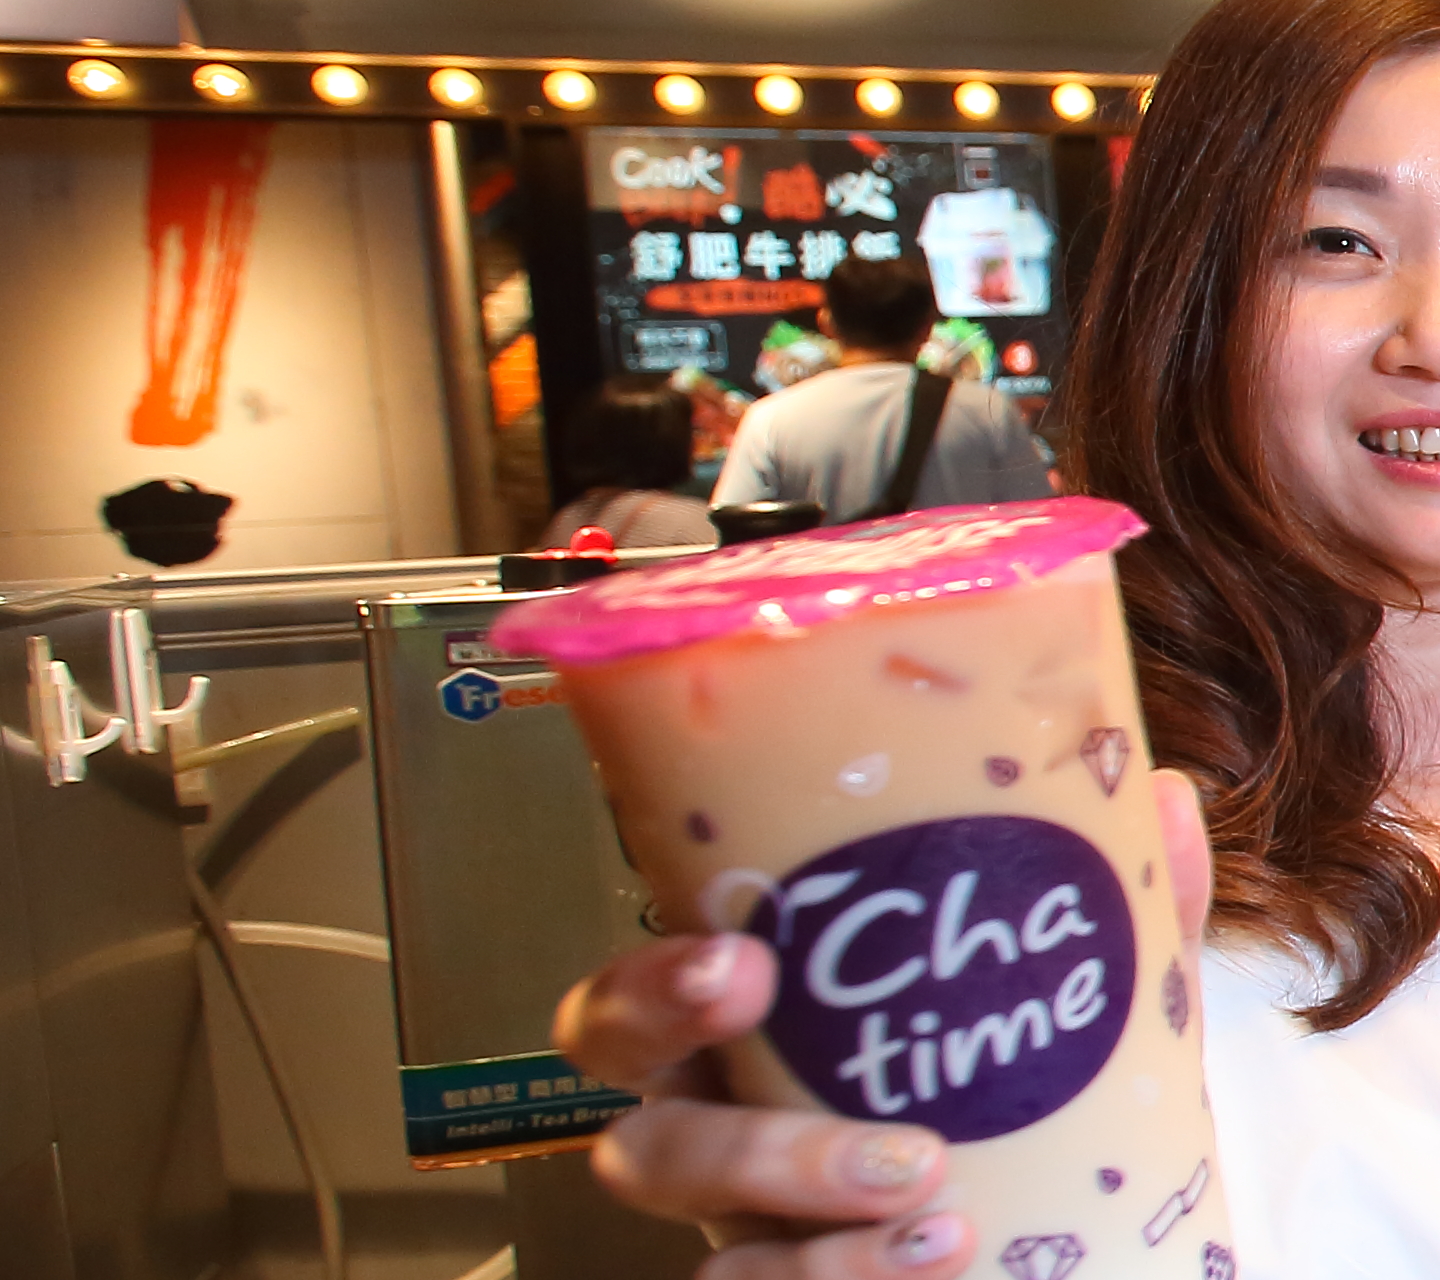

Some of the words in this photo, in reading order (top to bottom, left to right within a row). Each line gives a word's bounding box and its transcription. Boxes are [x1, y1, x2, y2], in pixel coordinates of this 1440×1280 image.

[805, 869, 1098, 1008] Cha
[836, 957, 1109, 1116] time
[529, 1113, 570, 1129] Tea
